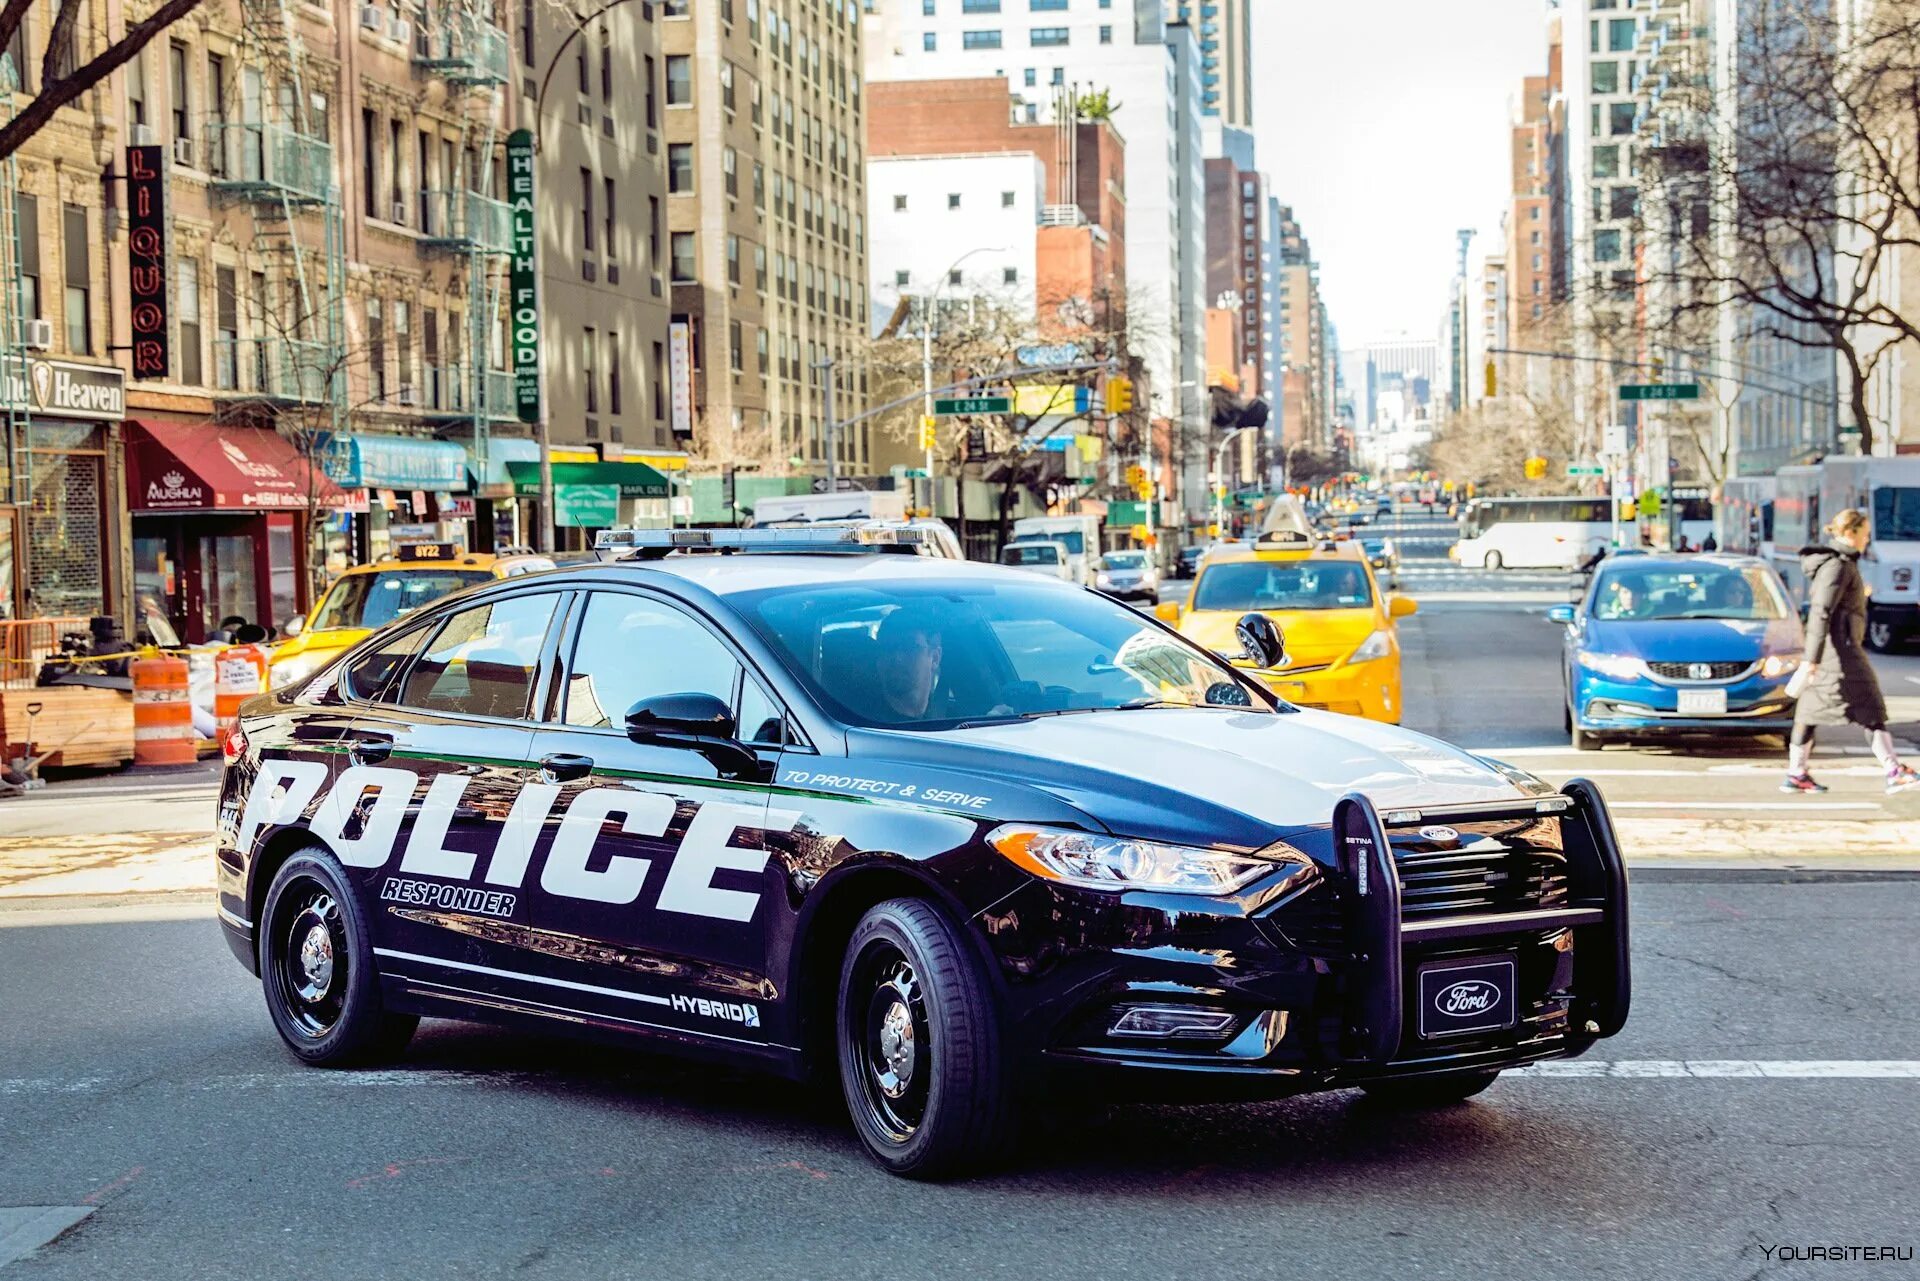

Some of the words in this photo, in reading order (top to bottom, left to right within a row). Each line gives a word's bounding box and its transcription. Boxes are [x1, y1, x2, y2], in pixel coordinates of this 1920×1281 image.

[513, 157, 534, 272] HEALTH
[130, 149, 164, 371] LIQUOR
[516, 288, 538, 363] FOOD
[54, 370, 120, 411] Heaven
[954, 401, 960, 411] E
[964, 401, 976, 411] 24
[979, 400, 989, 410] St
[783, 770, 809, 783] TO
[809, 773, 901, 794] PROTECT
[899, 785, 917, 797] &
[921, 788, 992, 809] SERVE
[235, 759, 799, 923] POLICE
[1345, 836, 1373, 845] SETINA
[380, 877, 516, 917] RESPONDER
[671, 993, 744, 1022] HYBRID
[1446, 985, 1490, 1011] Ford
